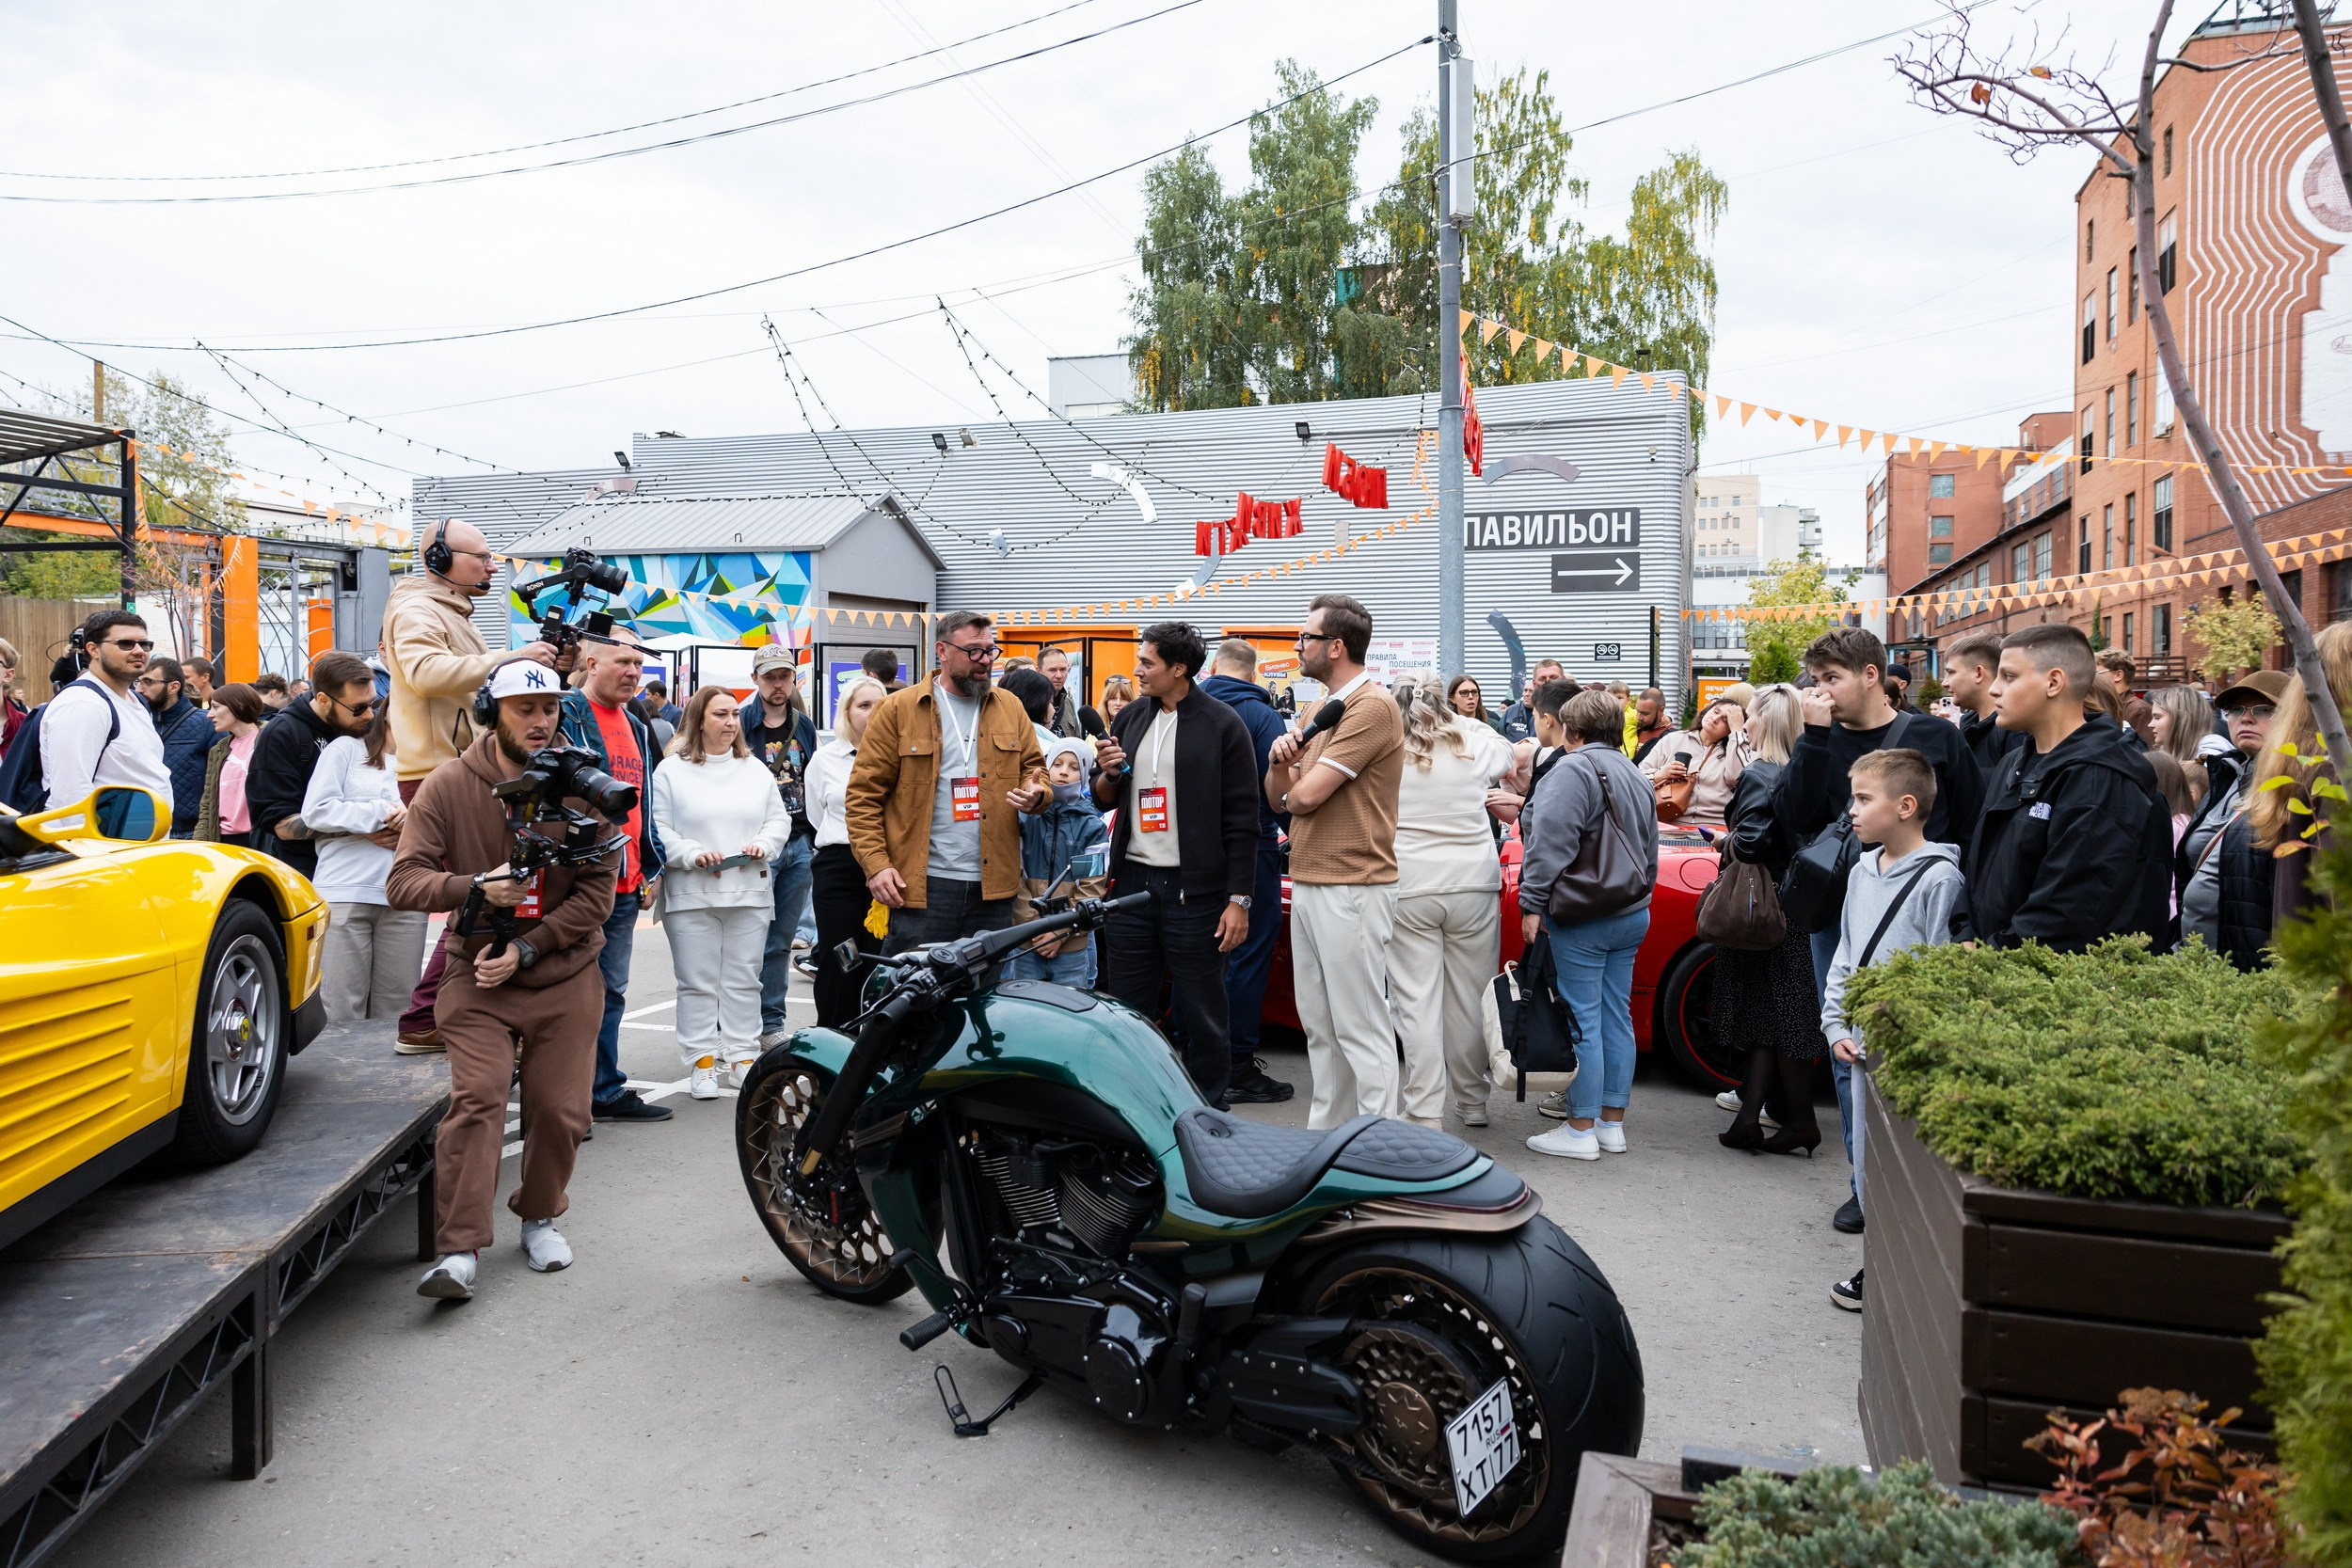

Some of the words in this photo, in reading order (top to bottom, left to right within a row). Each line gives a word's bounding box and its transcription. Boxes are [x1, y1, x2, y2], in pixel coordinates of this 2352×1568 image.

[1464, 512, 1631, 546] ПАВИЛЬОН
[527, 580, 545, 592] RONIN
[1389, 660, 1432, 669] ПОСЕЩЕНИЯ
[524, 669, 547, 689] NY
[610, 754, 643, 771] ARAGE
[1456, 1391, 1502, 1456] 7157
[1486, 1431, 1501, 1449] RUS
[1494, 1432, 1513, 1474] 77
